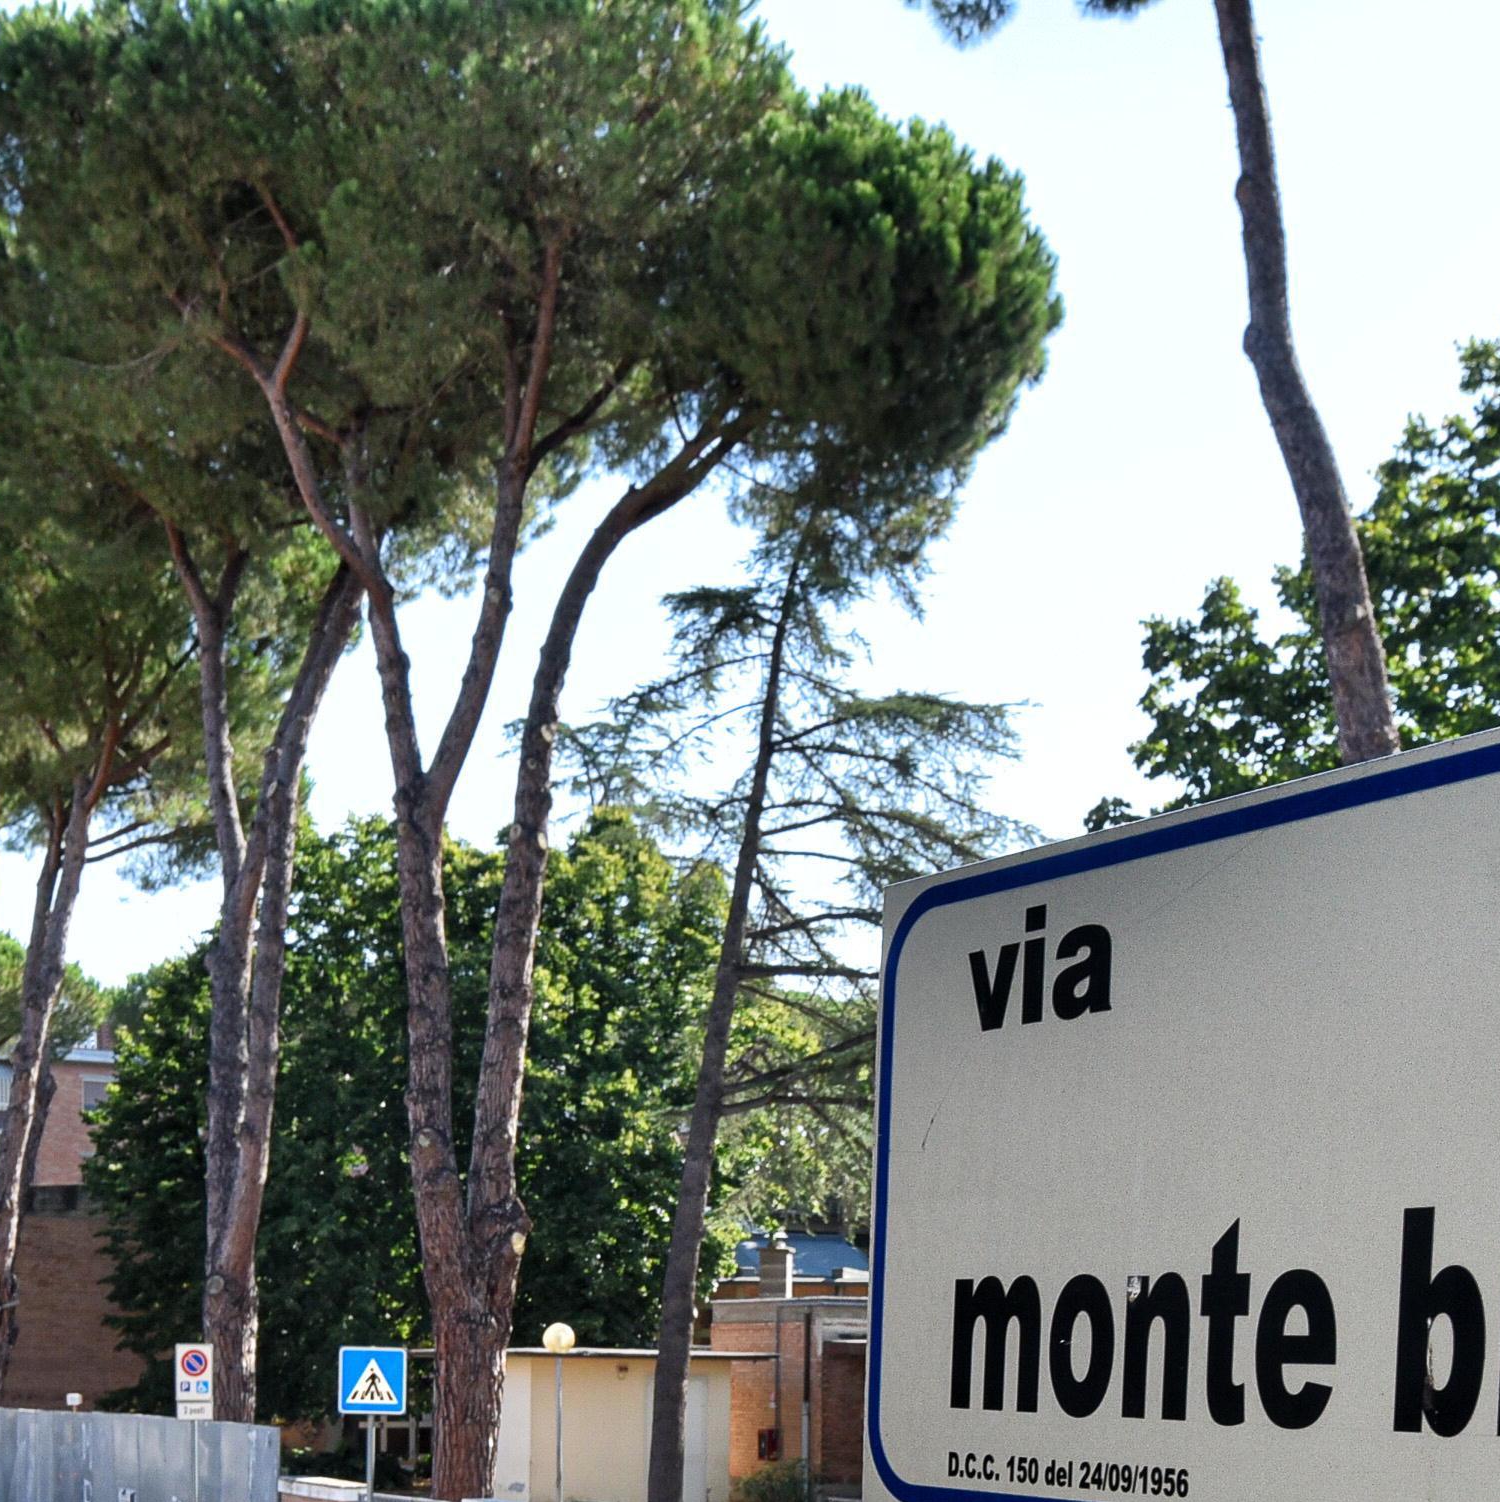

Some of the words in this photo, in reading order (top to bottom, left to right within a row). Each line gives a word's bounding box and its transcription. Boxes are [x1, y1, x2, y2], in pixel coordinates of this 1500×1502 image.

[969, 904, 1111, 1031] via
[951, 1219, 1336, 1429] monte
[948, 1452, 1000, 1481] D.C.C.
[1006, 1456, 1039, 1484] 150
[1045, 1460, 1073, 1488] del
[1079, 1461, 1189, 1498] 24/09/1956
